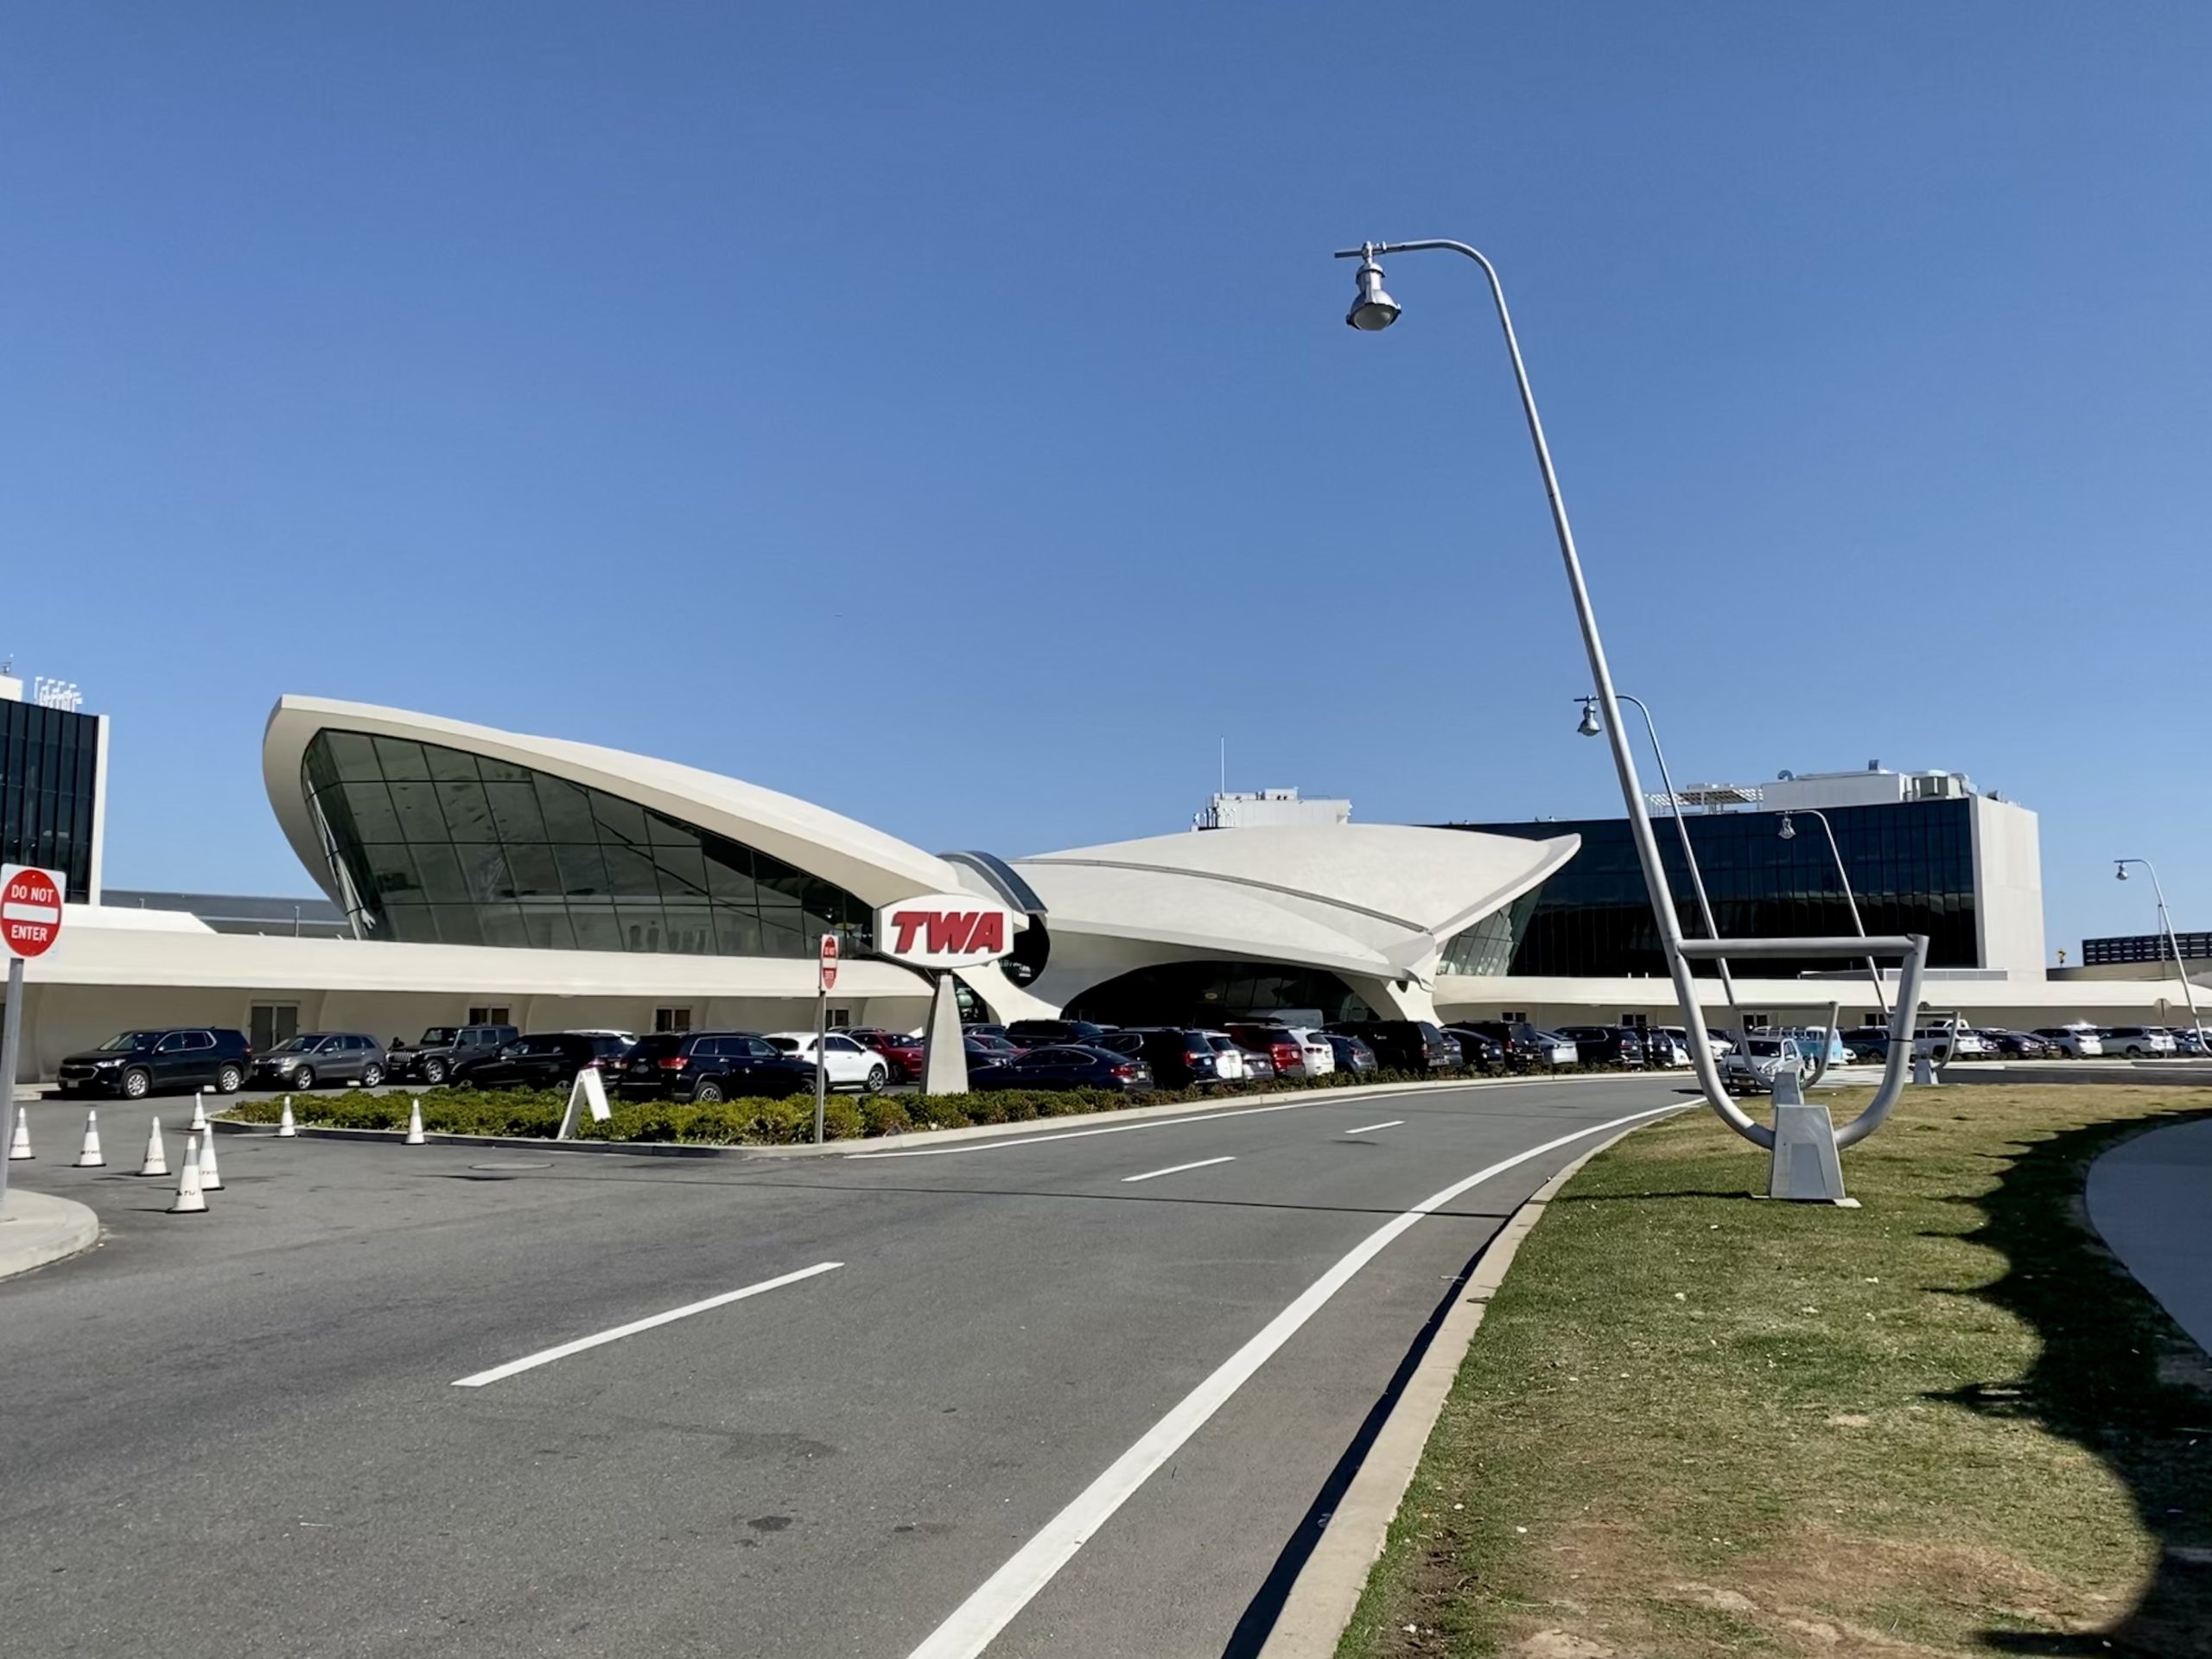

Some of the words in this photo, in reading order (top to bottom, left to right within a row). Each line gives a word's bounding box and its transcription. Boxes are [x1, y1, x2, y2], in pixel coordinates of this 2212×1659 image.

[11, 884, 28, 899] DO
[30, 887, 54, 903] NOT
[11, 925, 48, 942] ENTER
[891, 911, 1004, 954] TWA
